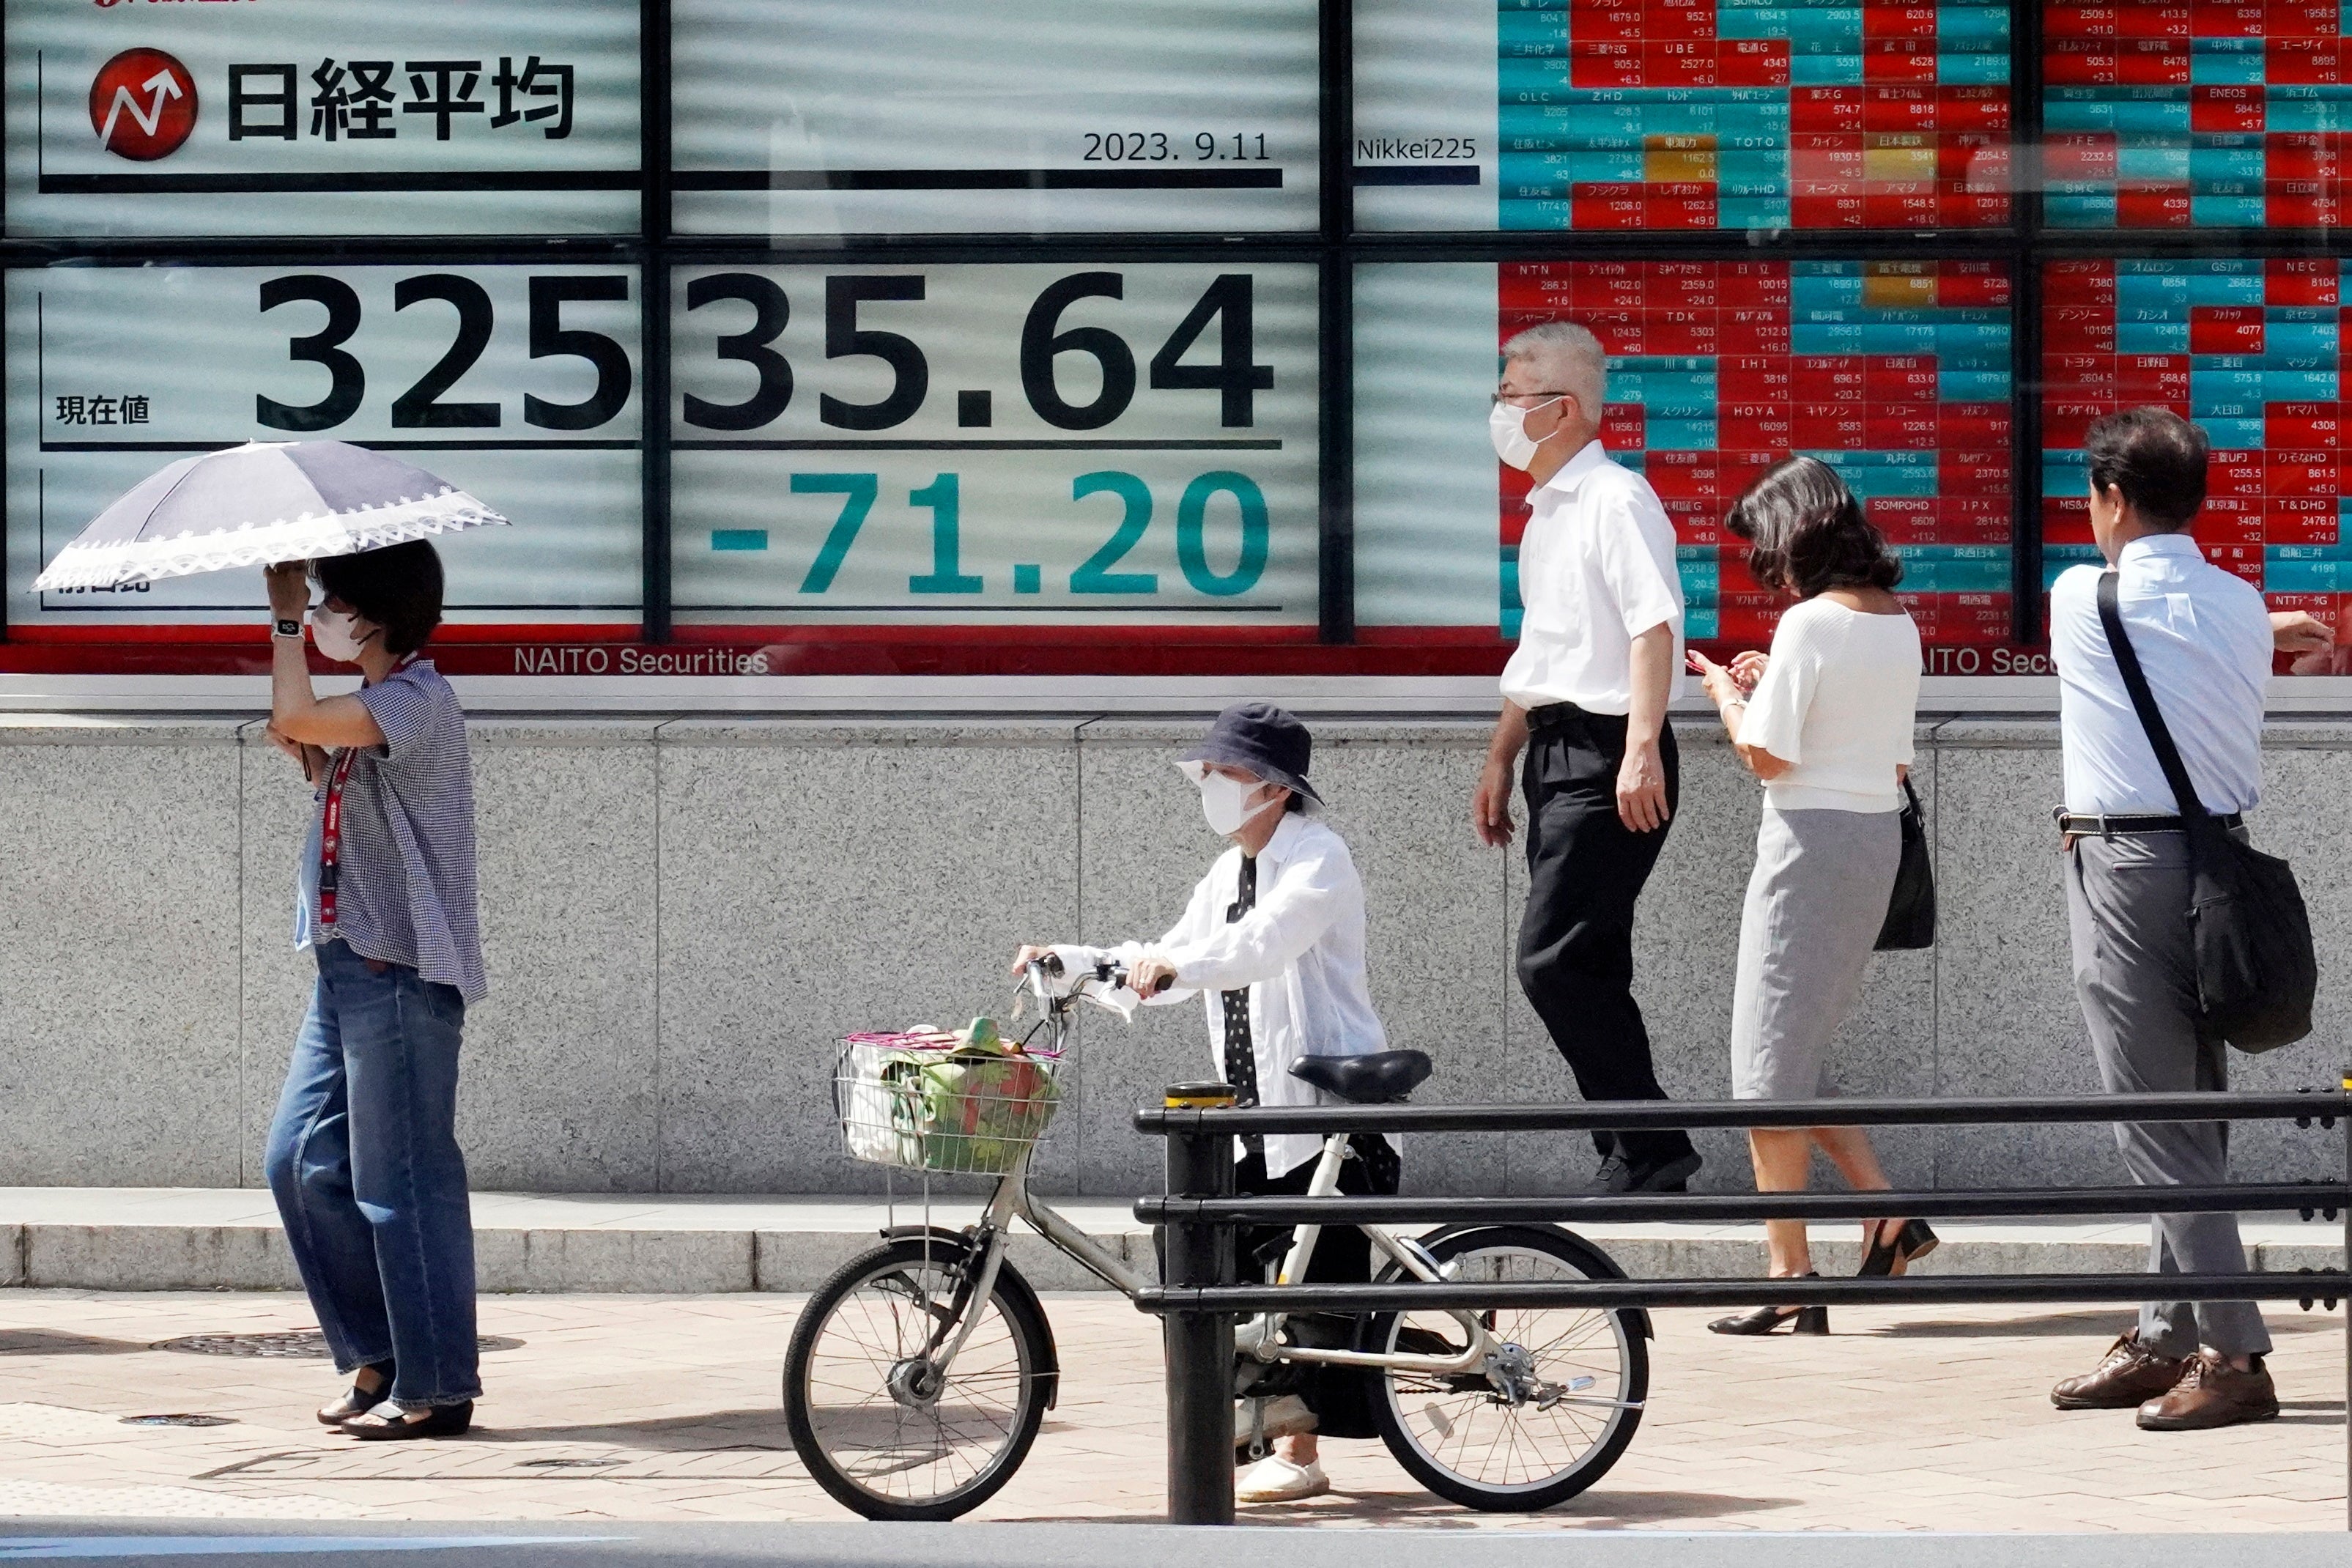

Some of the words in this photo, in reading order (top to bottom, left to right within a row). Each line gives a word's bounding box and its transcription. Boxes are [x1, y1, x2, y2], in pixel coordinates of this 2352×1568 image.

[1687, 12, 1714, 21] 952.1
[1907, 11, 1935, 20] 620.6
[2080, 10, 2113, 19] 2509.5
[2237, 9, 2261, 18] 6358
[2304, 7, 2336, 18] 1956.5
[1620, 28, 1640, 37] +6.5
[1693, 27, 1714, 37] +3.5
[2087, 25, 2113, 34] +31.0
[2167, 25, 2187, 34] +3.2
[2244, 24, 2261, 34] +82
[1665, 44, 1693, 53] UBE
[2282, 40, 2323, 49] エーザイ
[1614, 60, 1641, 69] 905.2
[1681, 59, 1714, 68] 2527.0
[1763, 59, 1788, 67] 4343
[1910, 57, 1936, 66] 4528
[2087, 57, 2113, 66] 505.3
[2163, 56, 2187, 66] 6478
[1693, 75, 1714, 84] +6.0
[1769, 74, 1788, 83] +27
[1916, 73, 1934, 81] +18
[2170, 72, 2189, 81] +15
[2318, 72, 2336, 81] +15
[1593, 91, 1622, 101] ZHD
[1812, 89, 1841, 99] 楽天G
[2210, 89, 2246, 97] ENEOS
[228, 55, 574, 141] 日経平均
[1834, 105, 1860, 114] 574.7
[1910, 104, 1934, 114] 8818
[1981, 104, 2007, 113] 464.4
[1840, 121, 1860, 129] +2.4
[2241, 119, 2262, 128] +5.7
[1736, 138, 1774, 147] TOTO
[1356, 138, 1476, 160] Nikkei225
[1830, 152, 1860, 161] 1930.5
[2312, 150, 2336, 160] 3798
[2318, 167, 2336, 177] +24
[1589, 185, 1629, 196] フジクラ
[1808, 184, 1848, 193] オークマ
[1683, 201, 1714, 210] 1262.5
[1837, 199, 1860, 209] 6931
[1903, 199, 1934, 208] 1548.5
[2164, 199, 2189, 208] 4339
[1621, 216, 1641, 226] +1.5
[1688, 216, 1715, 225] +49.0
[1844, 215, 1860, 224] +42
[2318, 213, 2336, 222] +53
[1520, 265, 1548, 274] NTN
[2287, 262, 2315, 272] NEC
[1541, 281, 1567, 290] 286.3
[1609, 281, 1641, 289] 1402.0
[1682, 280, 1714, 289] 2359.0
[1759, 280, 1788, 289] 10015
[2089, 278, 2114, 287] 7380
[2312, 278, 2335, 286] 8104
[1547, 296, 1568, 306] +1.6
[1614, 296, 1641, 305] +24.0
[1687, 295, 1714, 305] +24.0
[1764, 295, 1787, 303] +144
[2096, 294, 2112, 303] +24
[2318, 293, 2336, 302] +43
[1587, 312, 1627, 322] ソニーG
[1667, 312, 1694, 321] TDK
[2060, 309, 2100, 320] デンソー
[1612, 328, 1641, 337] 12435
[1690, 327, 1715, 336] 5303
[1756, 327, 1787, 336] 1212.0
[2085, 325, 2112, 335] 10105
[2237, 325, 2261, 334] 4077
[1623, 344, 1641, 352] +60
[1697, 343, 1715, 352] +13
[1761, 343, 1788, 352] +16.0
[1742, 359, 1766, 369] IHI
[2066, 358, 2095, 367] トヨタ
[2138, 358, 2168, 367] 日野自
[1764, 374, 1787, 383] 3816
[1833, 374, 1861, 383] 696.5
[1908, 374, 1935, 383] 633.0
[2080, 373, 2112, 382] 2604.5
[2160, 373, 2189, 383] 568.6
[1835, 390, 1861, 399] +20.2
[2092, 389, 2113, 399] +1.5
[56, 394, 149, 425] 現在値
[1734, 407, 1774, 415] HOYA
[1807, 406, 1848, 415] キヤノン
[1887, 406, 1916, 415] リコー
[2286, 405, 2318, 415] ヤマハ
[1610, 423, 1641, 432] 1956.0
[1759, 422, 1788, 431] 16095
[1838, 421, 1861, 431] 3583
[1903, 421, 1934, 431] 1226.5
[2311, 421, 2336, 430] 4308
[1621, 438, 1641, 447] +1.5
[1770, 437, 1788, 446] +35
[1843, 437, 1861, 446] +13
[2279, 453, 2326, 462] りそなHD
[2229, 468, 2261, 478] 1255.5
[2309, 468, 2335, 478] 861.5
[2235, 484, 2261, 493] +43.5
[2309, 484, 2336, 493] +45.0
[1875, 500, 1928, 510] SOMPOHD
[1962, 501, 1989, 511] JPX
[2238, 516, 2261, 525] 3408
[2302, 516, 2336, 525] 2476.0
[711, 470, 1271, 597] -71.20
[1694, 532, 1715, 541] +8.0
[2244, 532, 2261, 541] +32
[2309, 532, 2335, 541] +74.0
[2237, 563, 2261, 573] 3929
[514, 647, 609, 673] NAITO
[619, 648, 769, 673] Securities
[1923, 648, 1980, 674] ITO
